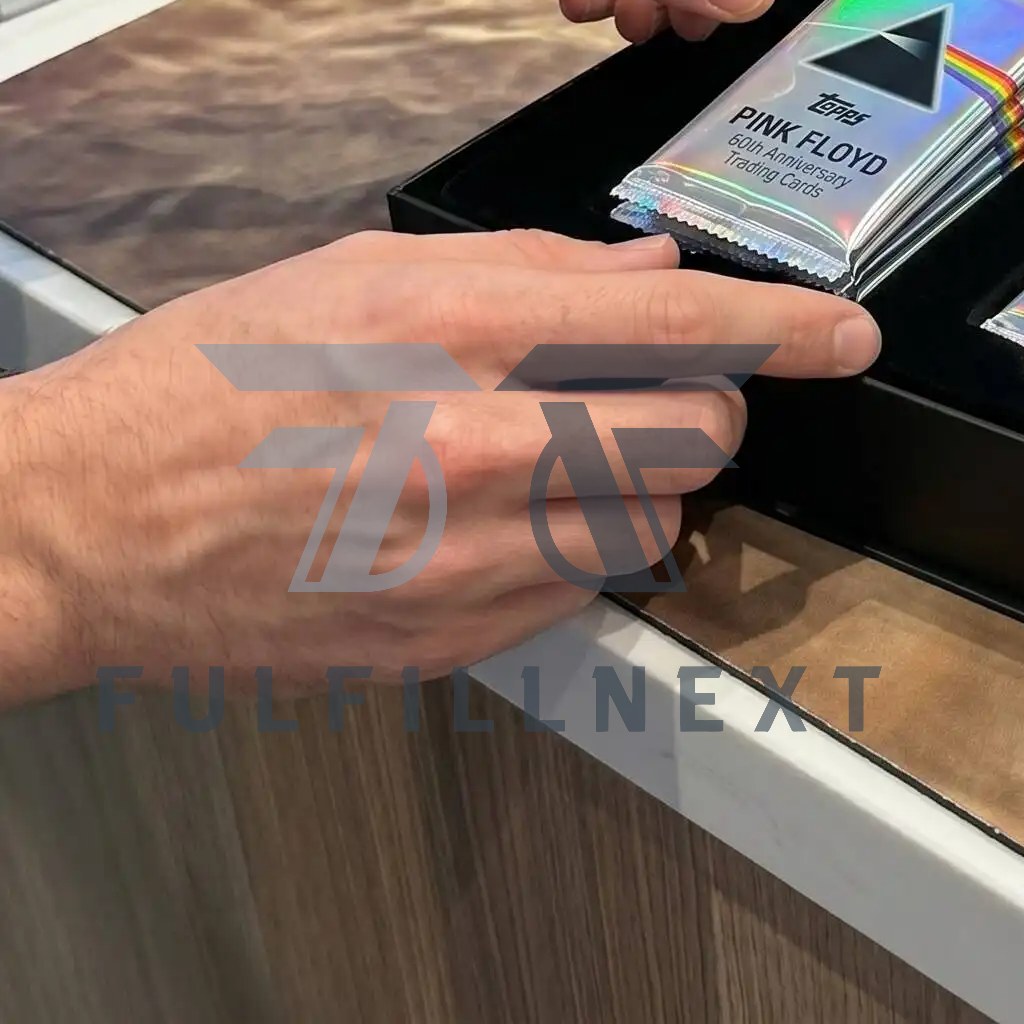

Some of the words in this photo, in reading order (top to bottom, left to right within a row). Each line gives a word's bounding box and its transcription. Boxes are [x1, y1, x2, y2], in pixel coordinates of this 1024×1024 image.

[728, 106, 802, 144] PINK
[796, 129, 888, 176] FLOYD
[728, 133, 764, 155] 60th
[763, 147, 853, 190] Anniversary
[724, 150, 780, 185] Trading
[780, 173, 824, 198] Cards
